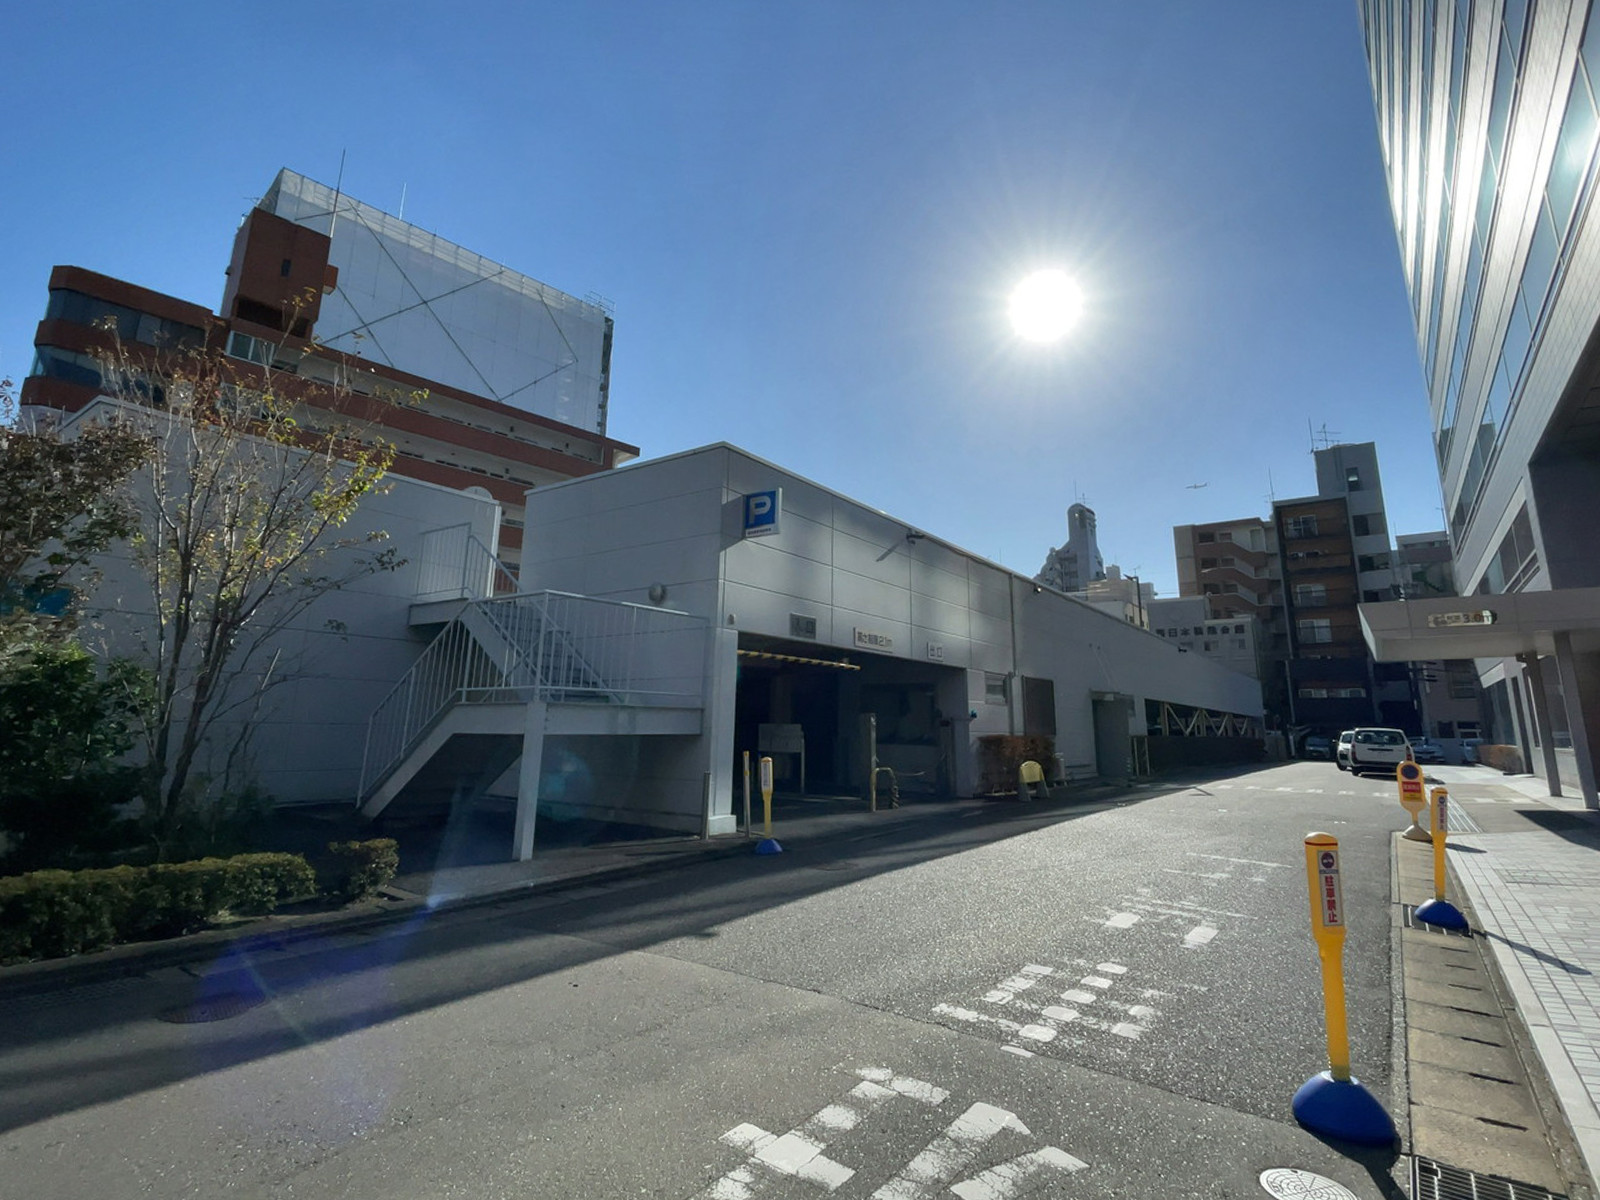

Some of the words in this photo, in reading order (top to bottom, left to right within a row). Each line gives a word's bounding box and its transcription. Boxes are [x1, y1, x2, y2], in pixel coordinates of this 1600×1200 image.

[749, 495, 771, 524] P
[1325, 875, 1337, 923] 駐車禁止
